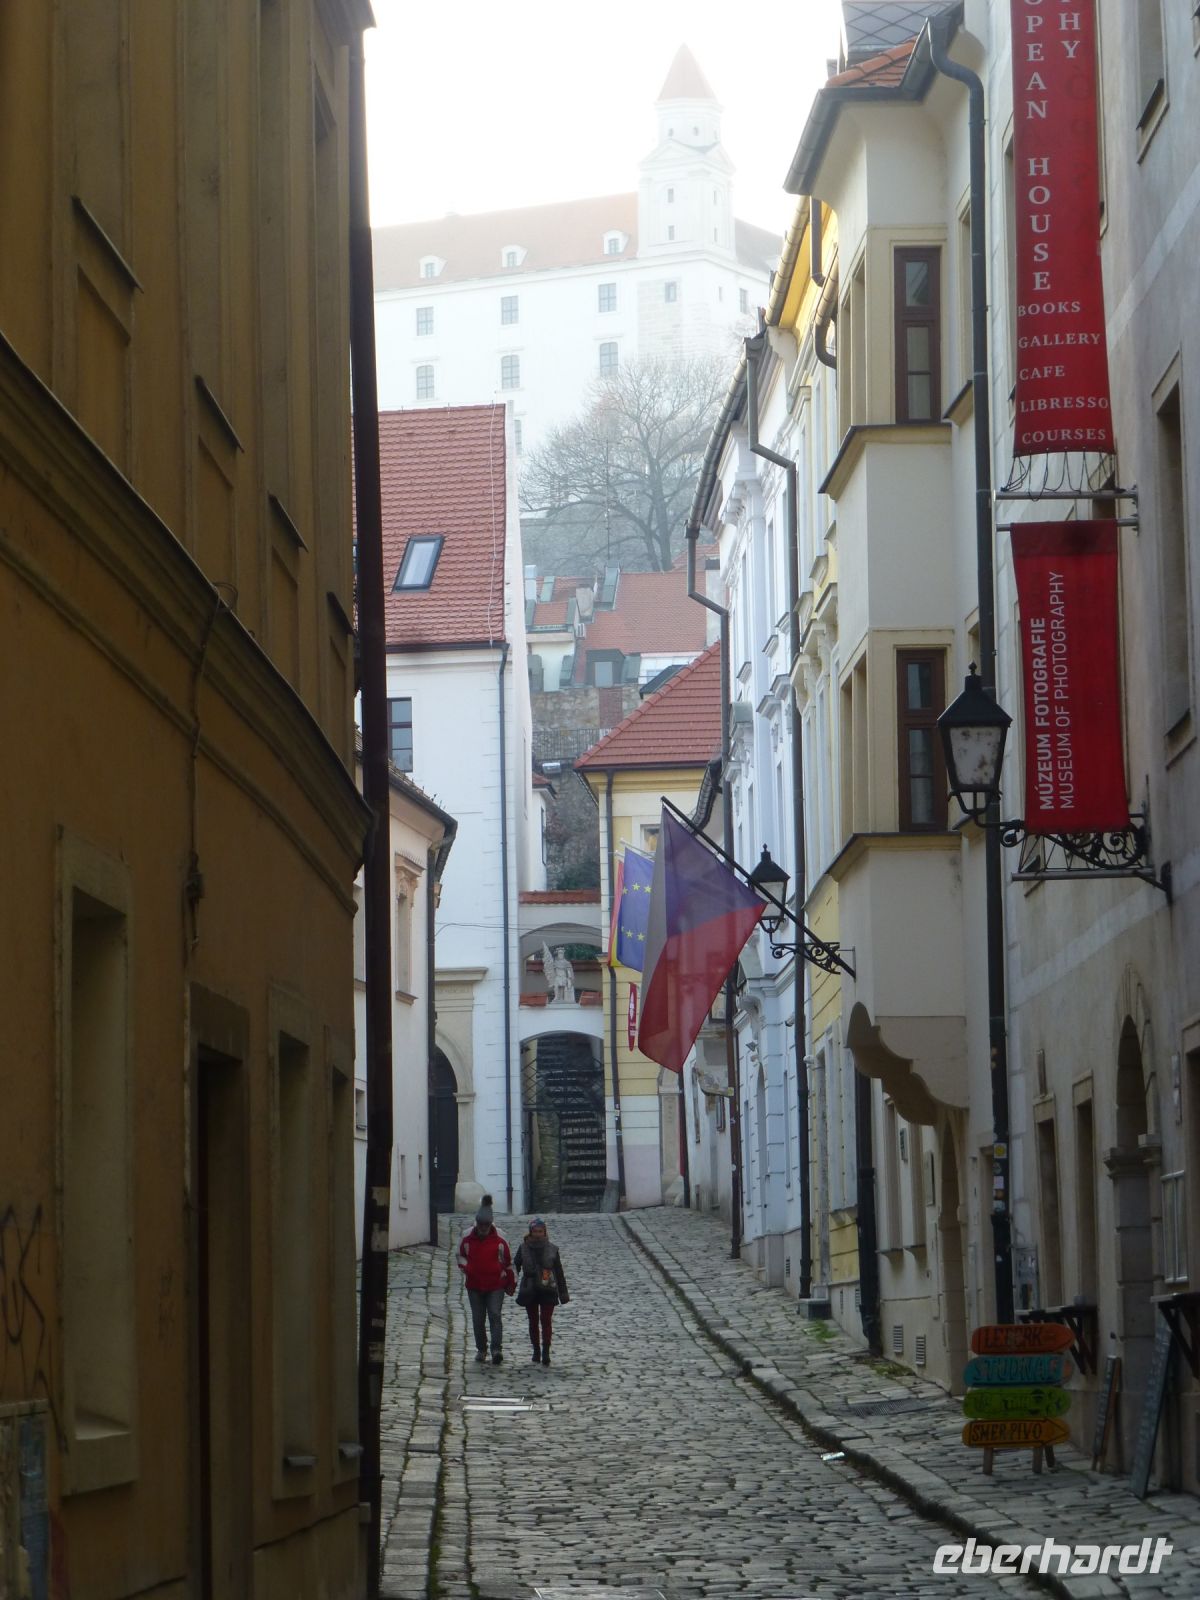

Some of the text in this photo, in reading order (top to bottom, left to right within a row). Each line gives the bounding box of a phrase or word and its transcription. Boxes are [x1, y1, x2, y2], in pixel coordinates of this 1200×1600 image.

[1058, 0, 1080, 58] HY
[1024, 0, 1051, 291] PEAN HOUSE
[1018, 301, 1081, 317] BOOKS
[1018, 333, 1101, 349] GALLERY
[1019, 365, 1066, 381] CAFE
[1020, 396, 1110, 413] LIBRESSO
[1022, 429, 1107, 445] COURSES
[1049, 571, 1075, 809] MUSEUM OF PHOTOGRAPHY
[1030, 618, 1055, 810] MÚZEUM FOTOGRAFIE
[1010, 1423, 1042, 1440] PIVO
